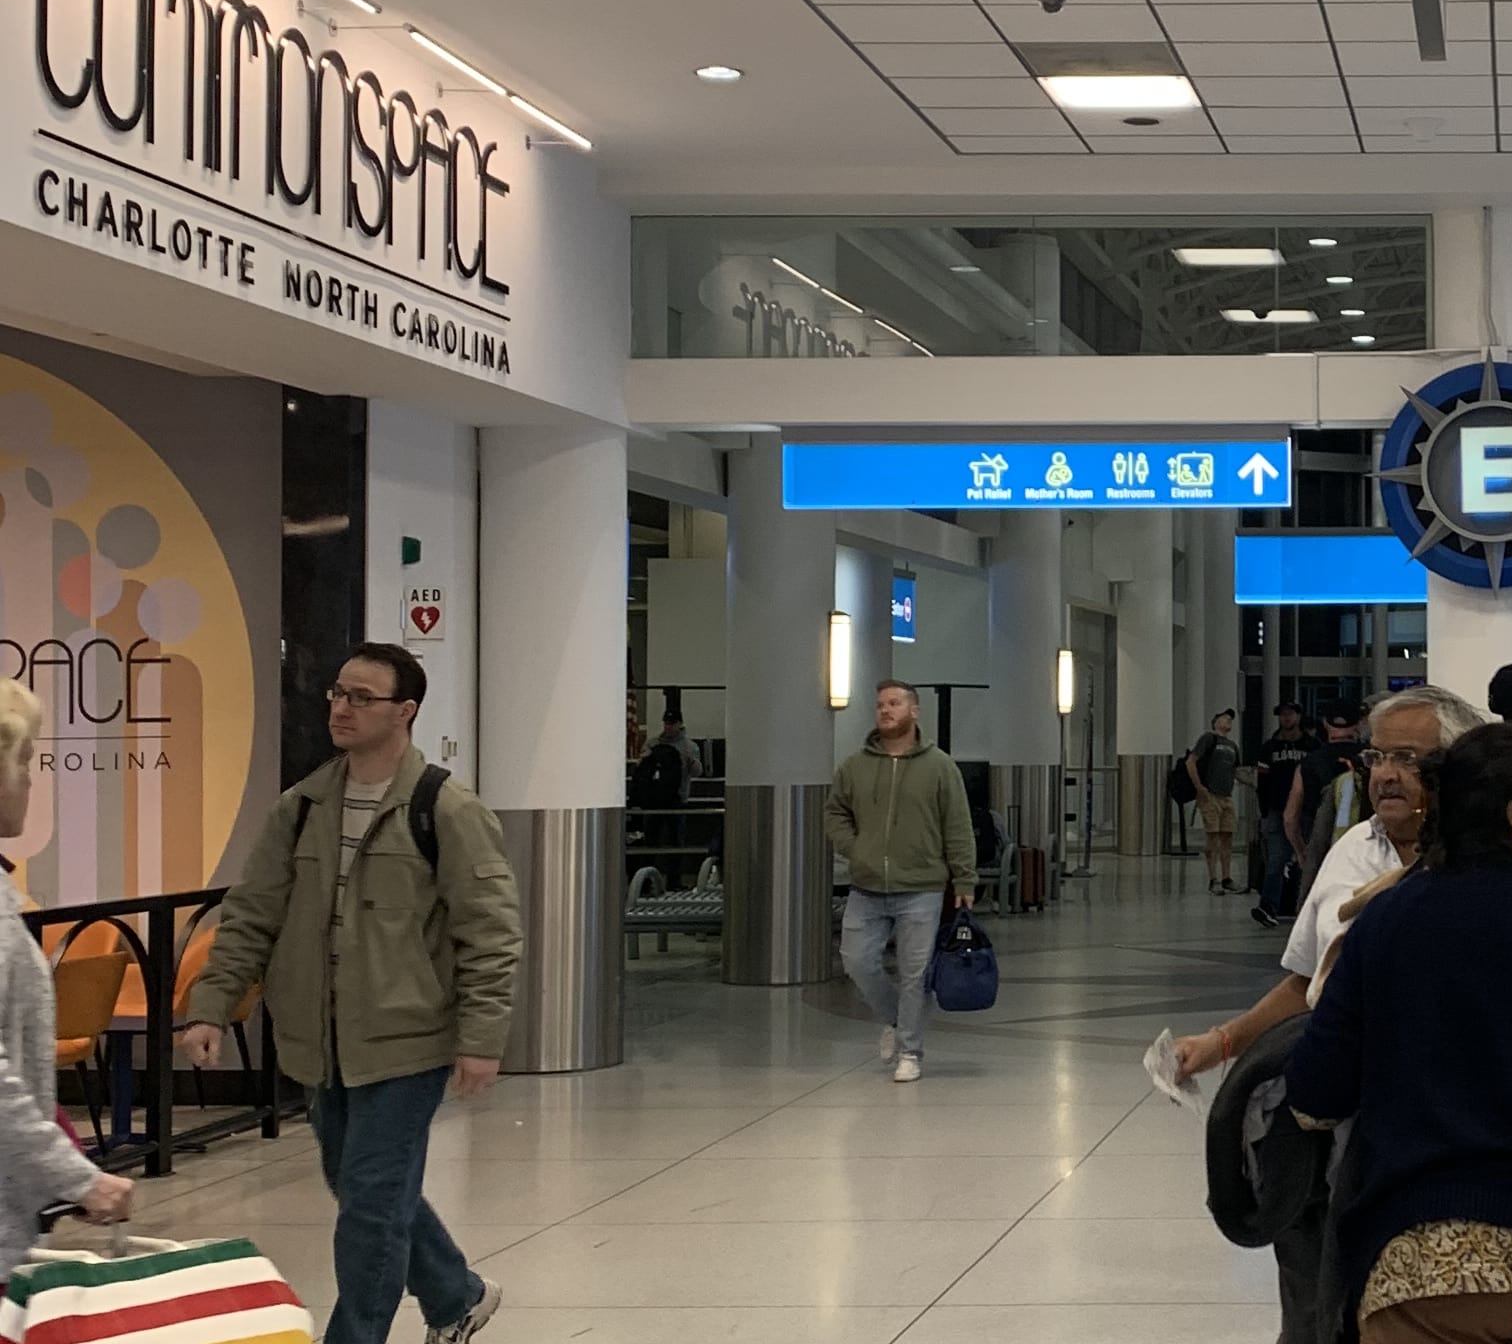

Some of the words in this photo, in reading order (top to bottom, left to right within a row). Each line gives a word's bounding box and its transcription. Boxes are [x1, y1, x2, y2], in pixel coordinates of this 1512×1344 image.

[37, 168, 256, 286] CHARLOTTE
[283, 259, 379, 329] NORTH
[391, 302, 512, 375] CAROLINA
[966, 488, 983, 500] Pet
[985, 488, 1011, 500] Relief
[1025, 488, 1065, 501] Mother's
[1067, 488, 1093, 500] Room
[1107, 488, 1155, 500] Restrooms
[1171, 487, 1213, 500] Elevators
[411, 589, 441, 602] AED
